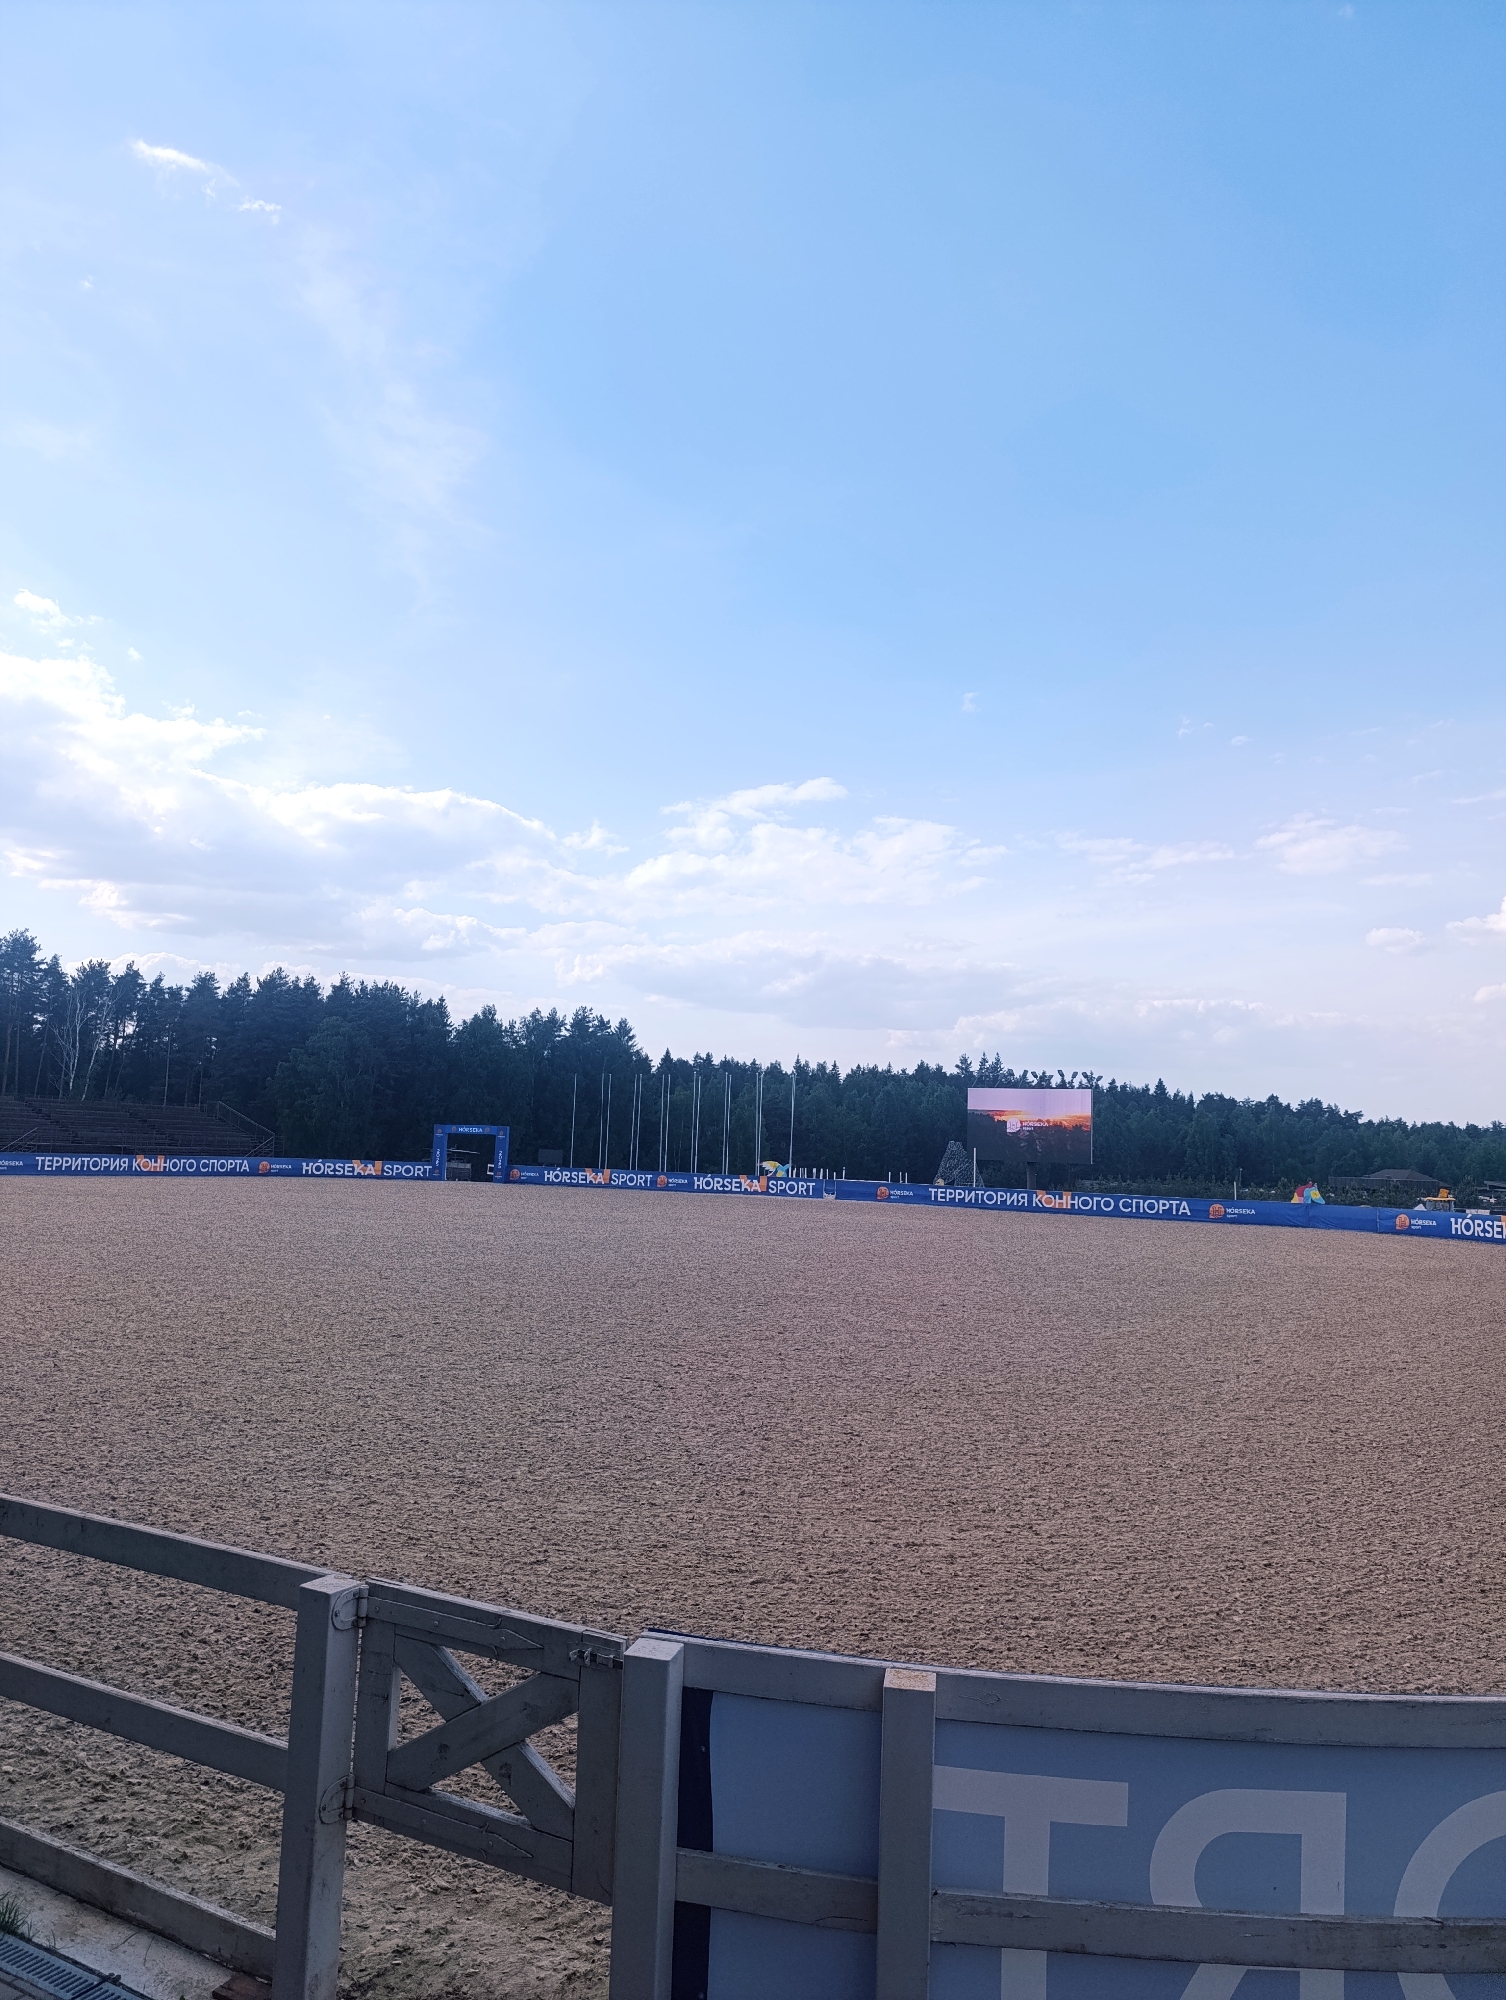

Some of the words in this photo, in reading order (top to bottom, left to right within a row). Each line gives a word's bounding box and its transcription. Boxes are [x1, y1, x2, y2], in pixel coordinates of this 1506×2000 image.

[0, 1159, 24, 1167] ÓRSEKA
[35, 1156, 128, 1171] ТЕРРИТОРИЯ
[132, 1157, 197, 1172] КОННОГО
[199, 1159, 250, 1173] СПОРТА
[302, 1159, 376, 1176] HÓRSEKA
[383, 1164, 433, 1178] SPORT
[543, 1167, 605, 1185] HÓRSEKA
[610, 1173, 653, 1187] SPORT
[693, 1173, 762, 1193] HÓRSEKA
[768, 1180, 816, 1196] SPORT
[928, 1187, 1028, 1207] ТЕРРИТОРИЯ
[1031, 1193, 1114, 1212] КОННОГО
[1118, 1198, 1191, 1216] СПОРТА
[1225, 1206, 1256, 1215] HÓRSEKA
